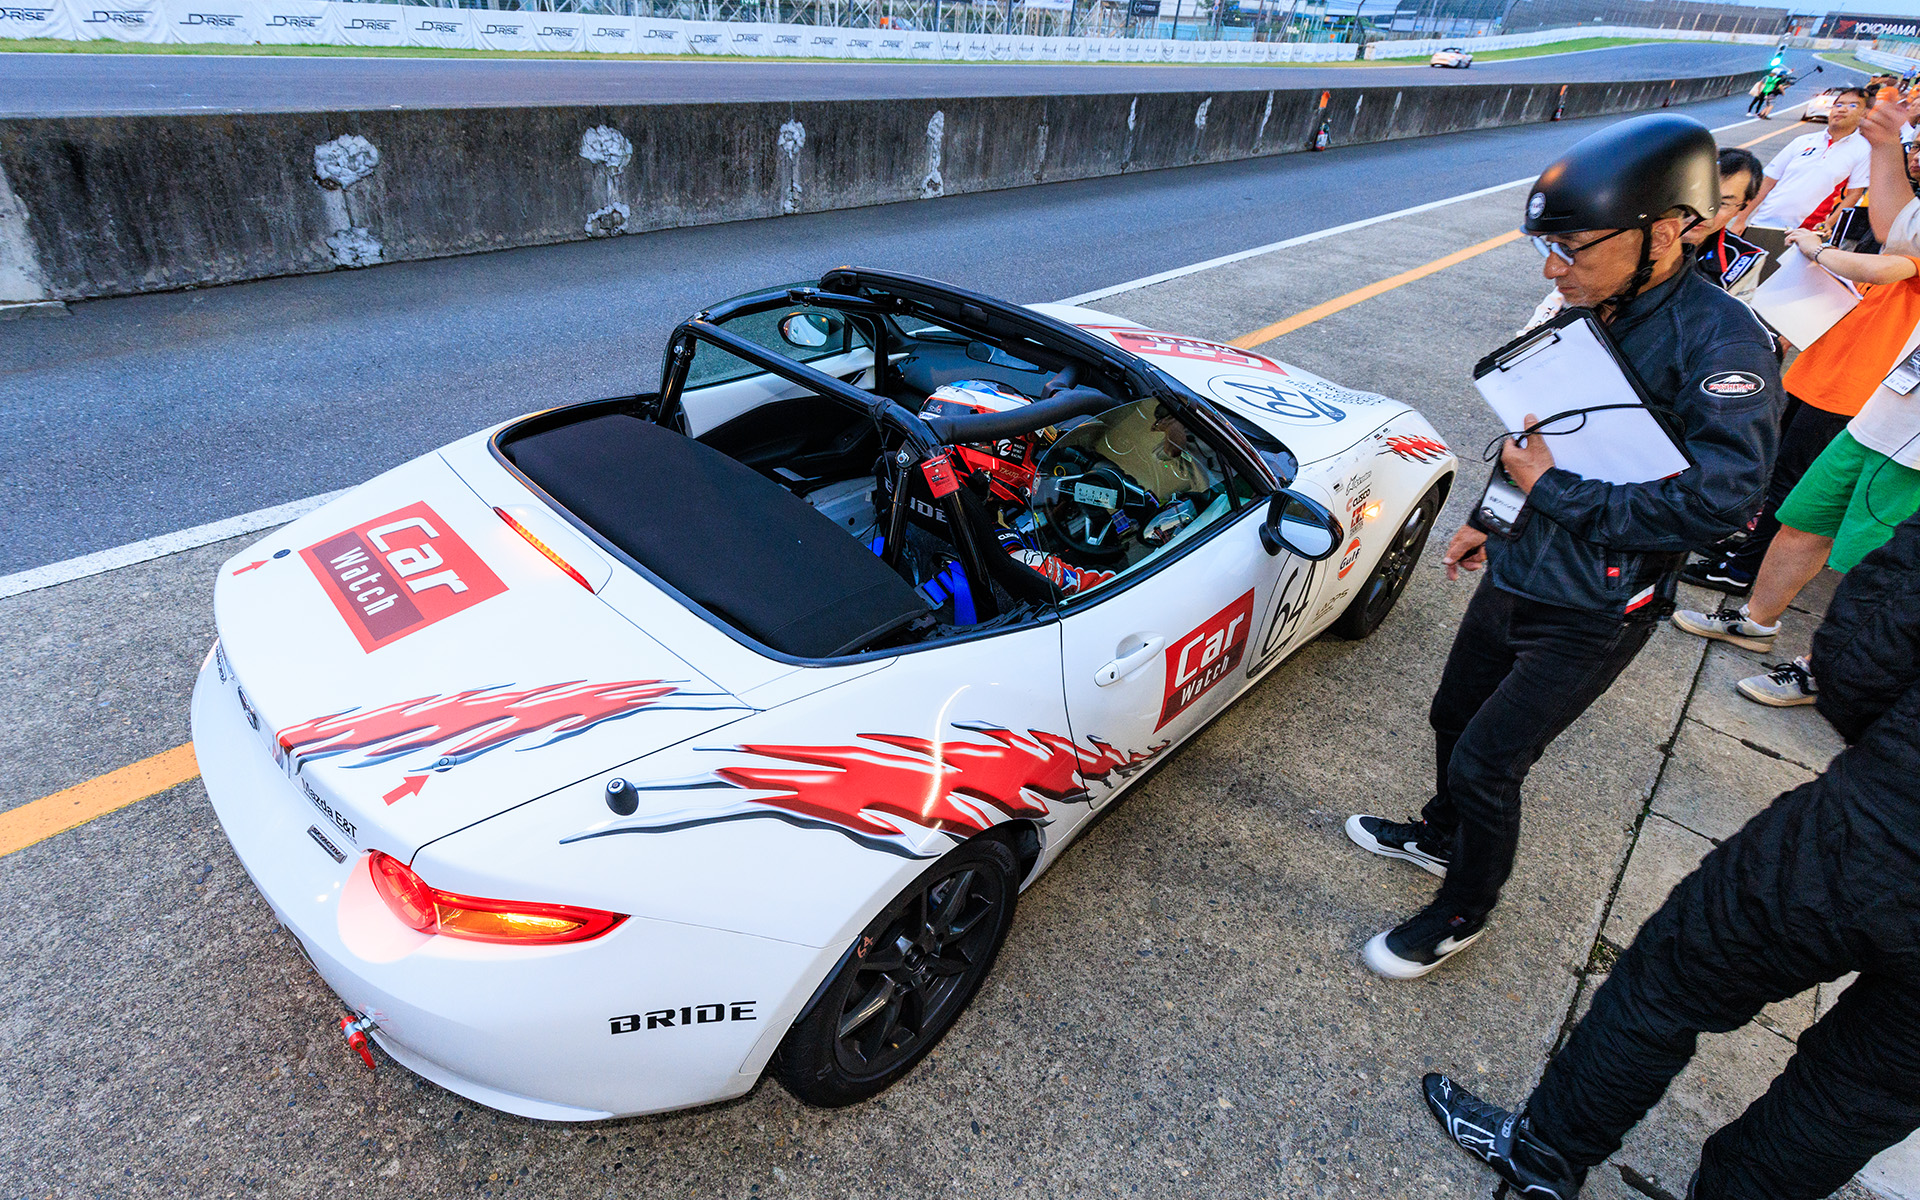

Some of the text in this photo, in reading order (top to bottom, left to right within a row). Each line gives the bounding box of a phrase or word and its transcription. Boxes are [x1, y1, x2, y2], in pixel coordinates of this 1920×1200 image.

[1854, 23, 1916, 36] YOKOHAMA
[1140, 343, 1263, 368] Car
[1223, 380, 1321, 420] 64
[366, 516, 470, 596] Car
[1340, 548, 1361, 571] Gulf
[329, 546, 399, 616] Watch
[1260, 560, 1318, 658] 64
[1175, 612, 1246, 688] Car
[1180, 655, 1231, 706] Watch
[335, 810, 357, 838] E&T
[857, 936, 874, 958] 64
[608, 1000, 757, 1035] BRIDE
